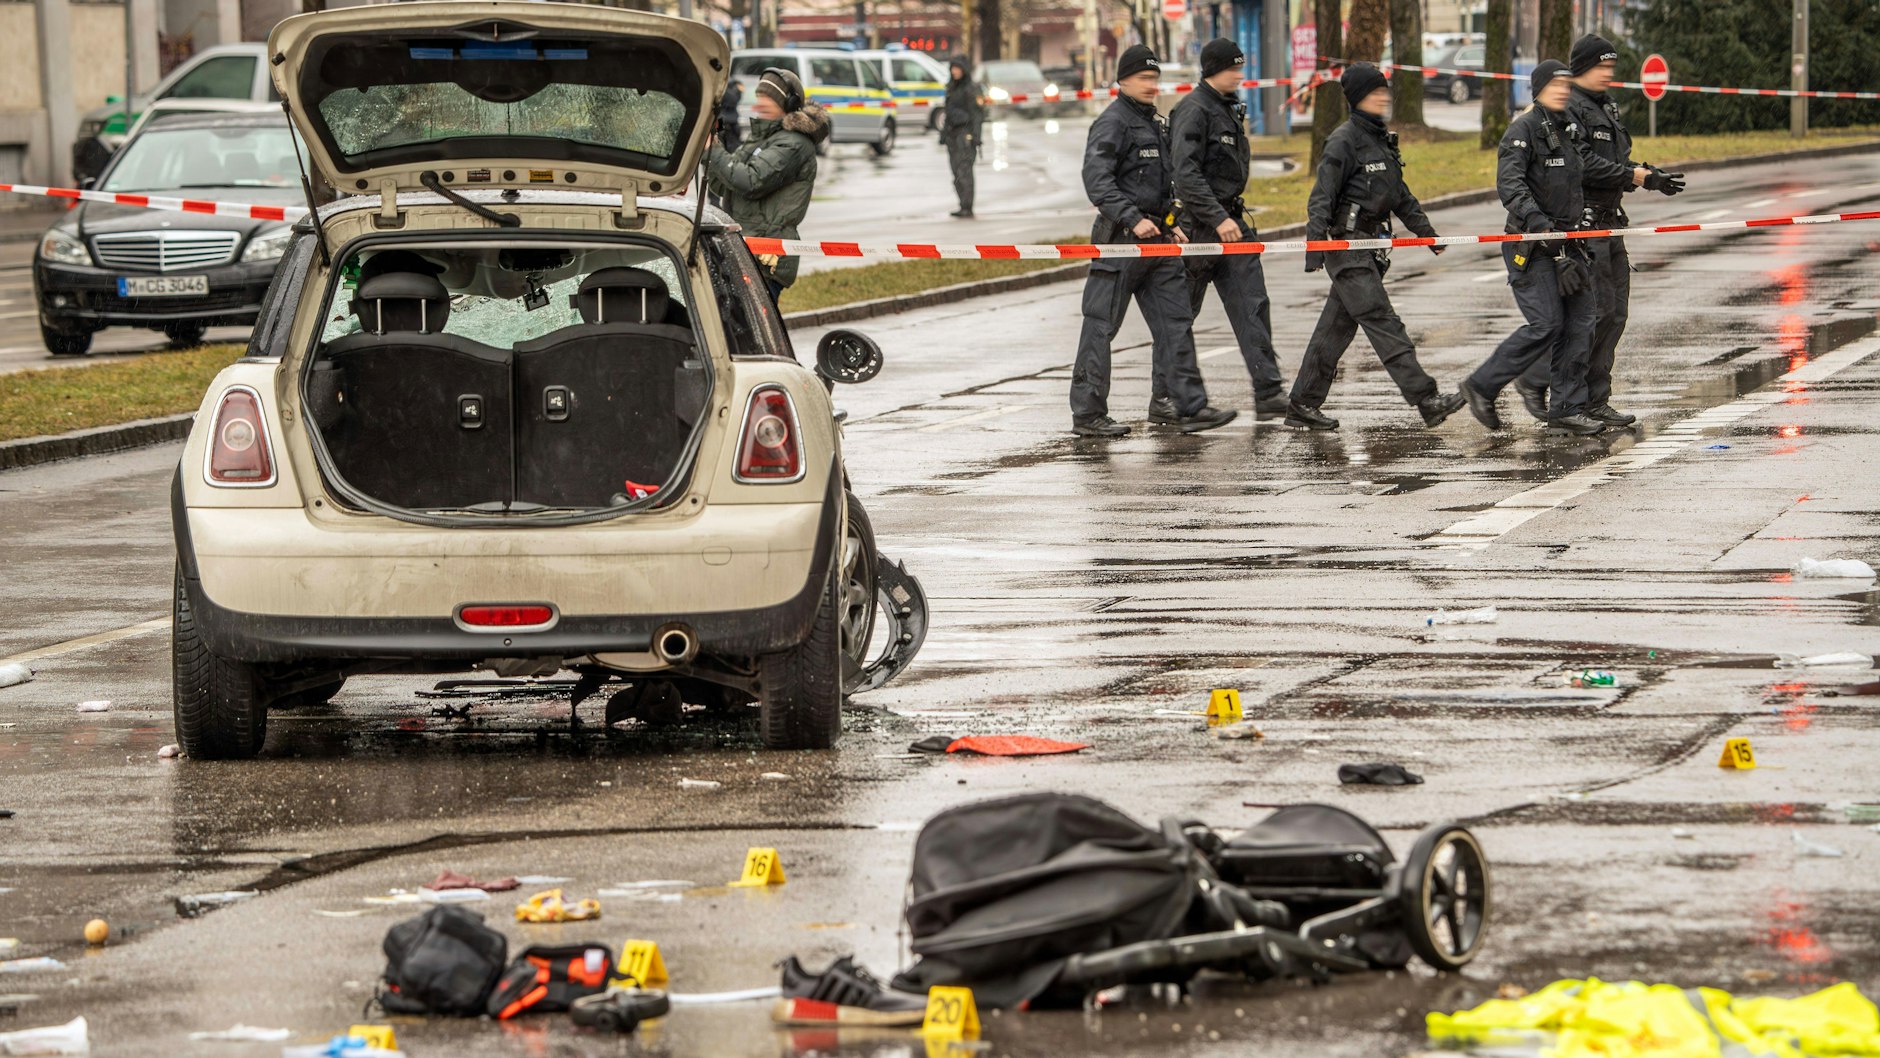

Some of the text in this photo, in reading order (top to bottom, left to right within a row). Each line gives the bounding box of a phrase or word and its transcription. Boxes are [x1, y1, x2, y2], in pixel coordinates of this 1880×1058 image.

[1224, 694, 1233, 711] 1
[1734, 743, 1751, 762] 15
[750, 855, 768, 877] 16
[628, 949, 647, 973] 11
[931, 997, 961, 1024] 20
